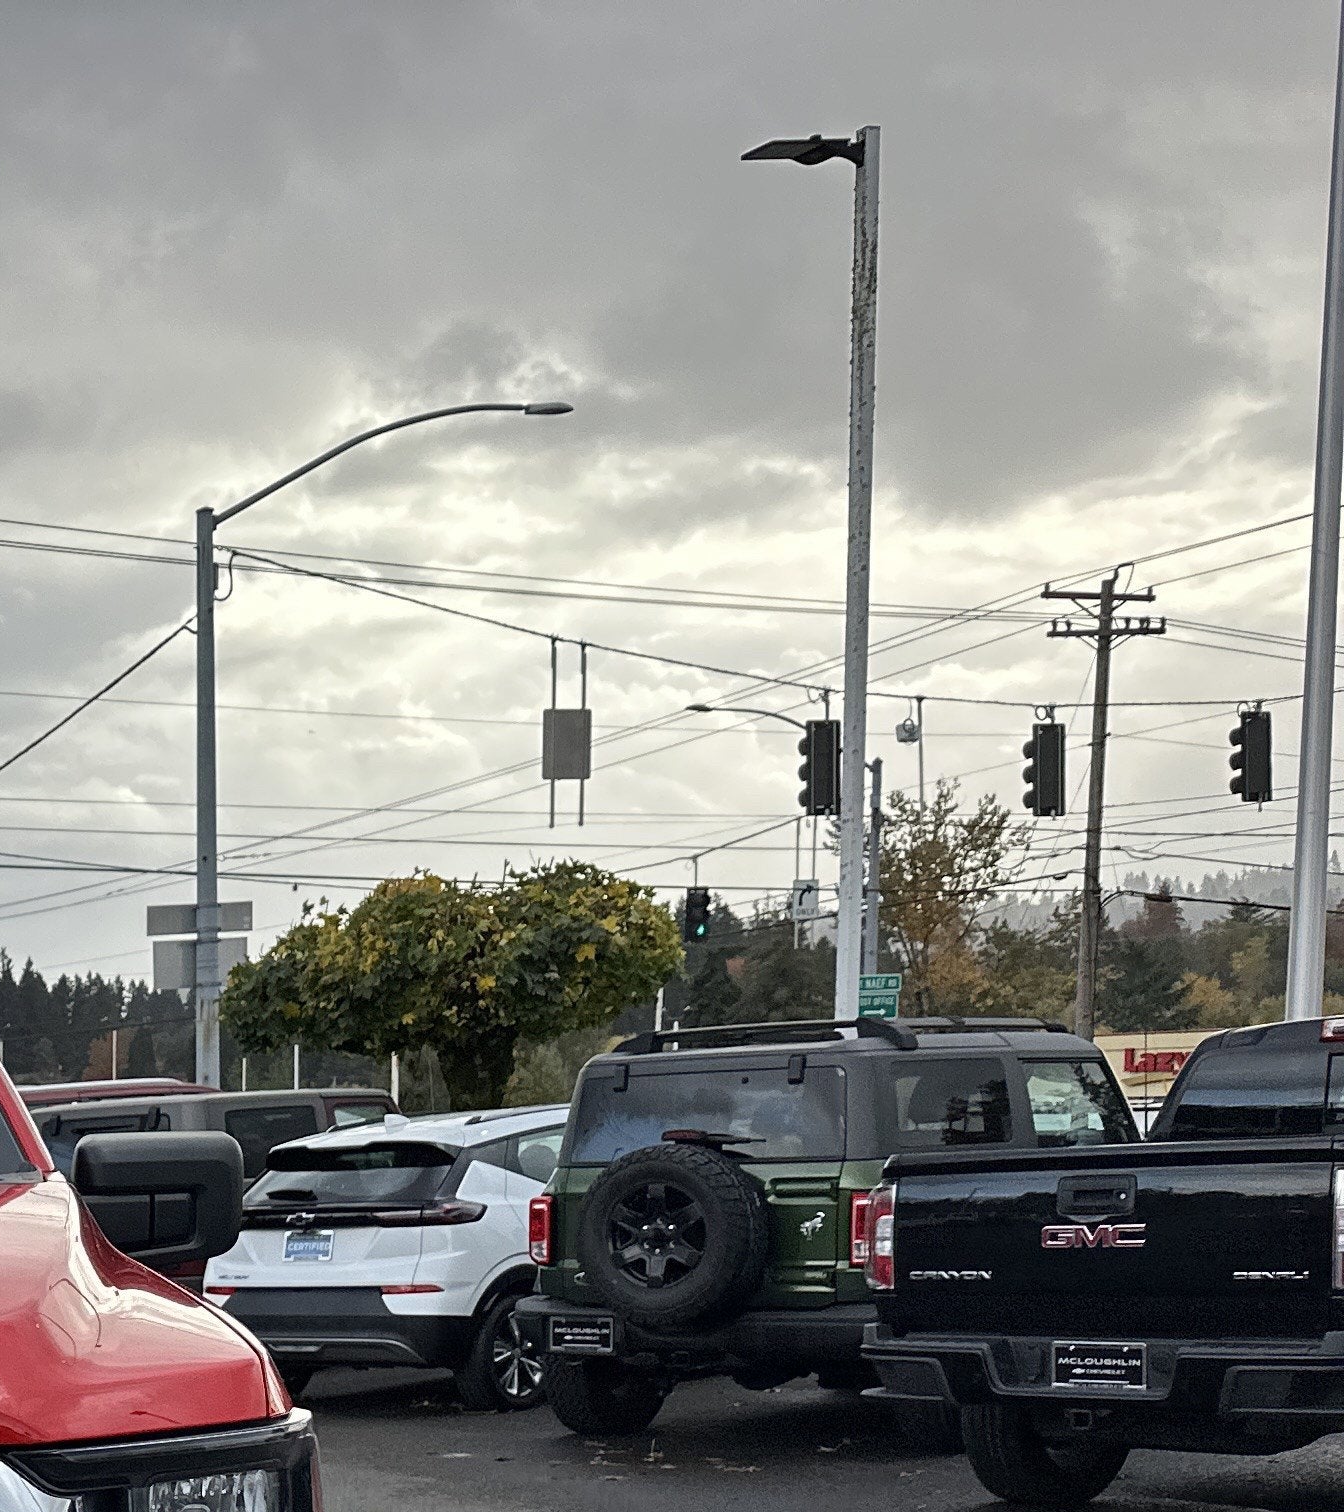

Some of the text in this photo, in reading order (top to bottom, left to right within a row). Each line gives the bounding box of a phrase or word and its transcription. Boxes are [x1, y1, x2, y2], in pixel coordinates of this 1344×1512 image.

[1041, 1223, 1147, 1249] GMC
[909, 1270, 993, 1281] CANYON
[1058, 1357, 1141, 1366] MCLOUGHLIN
